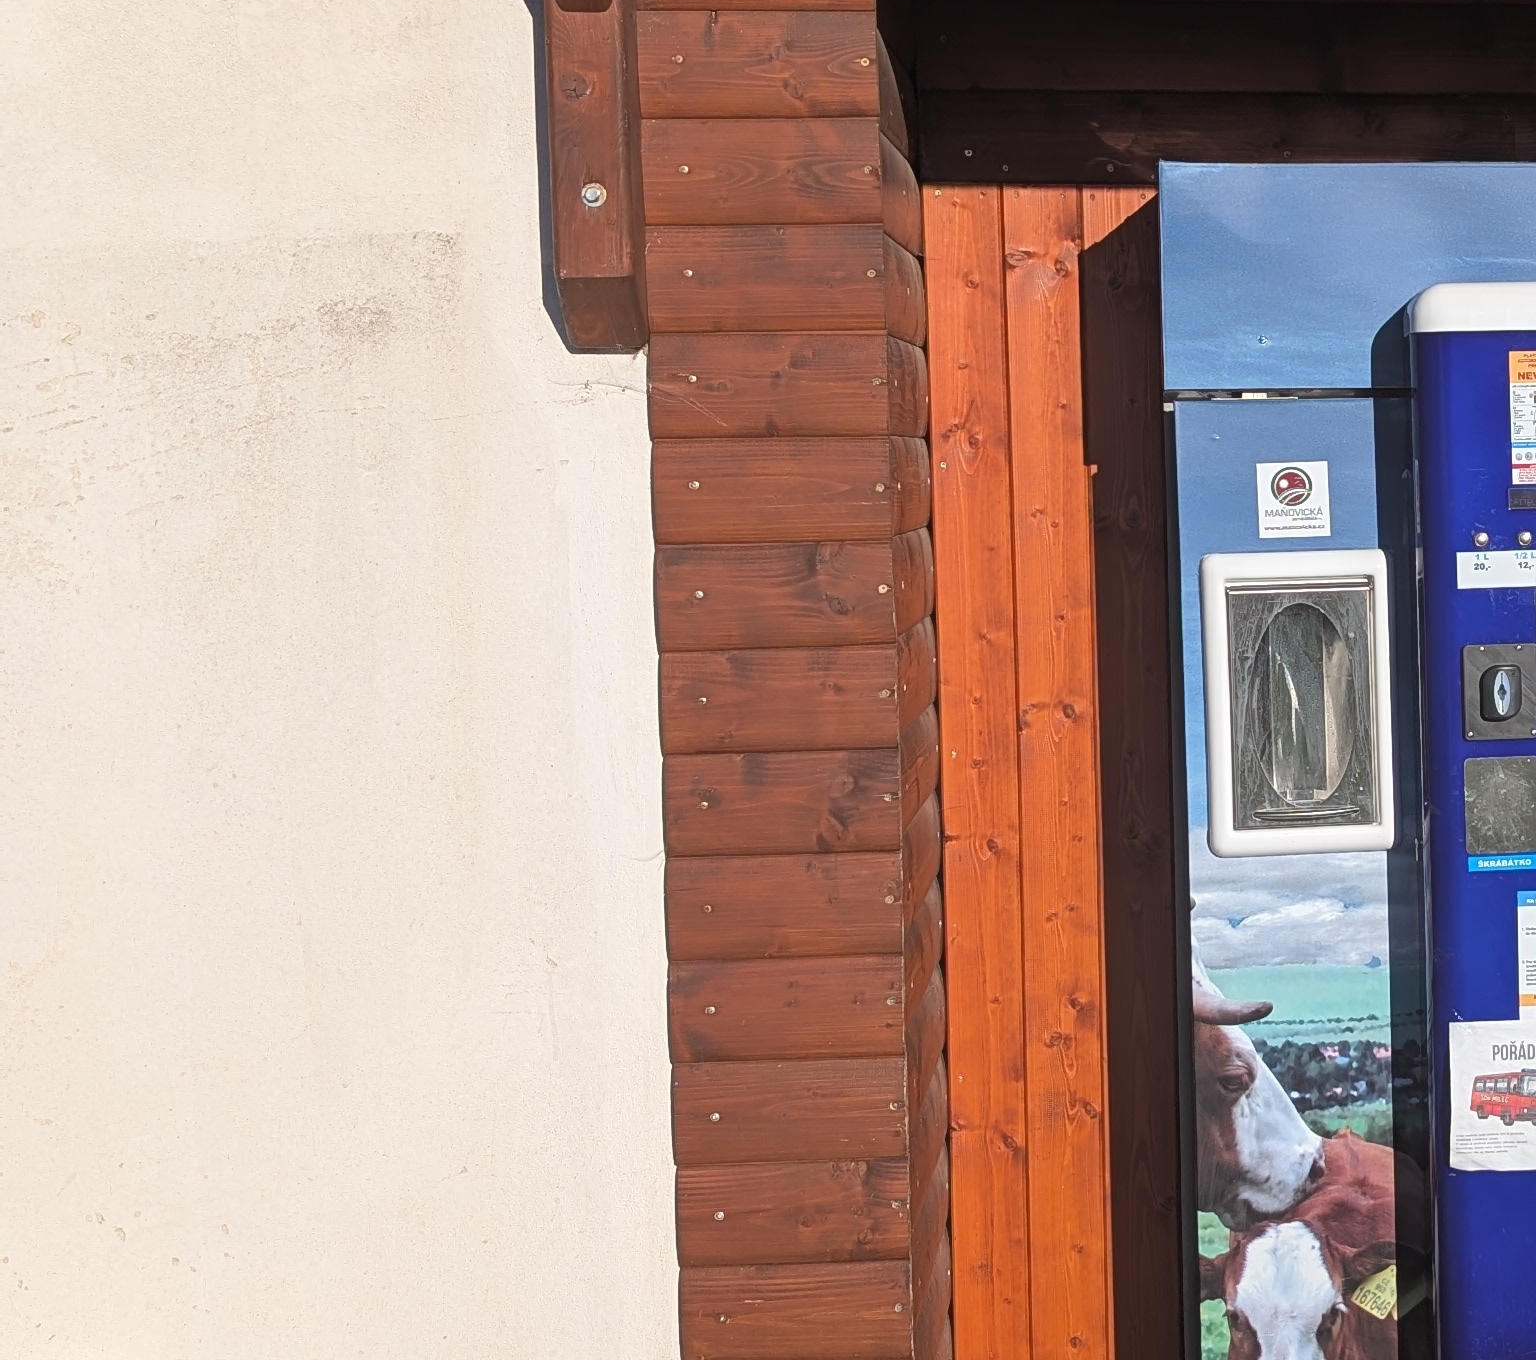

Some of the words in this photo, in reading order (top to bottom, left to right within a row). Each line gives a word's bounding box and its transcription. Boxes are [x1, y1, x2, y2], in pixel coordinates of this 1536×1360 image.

[1265, 506, 1323, 517] MAŇOVICKÁ
[1474, 563, 1491, 571] 20,-
[1518, 562, 1534, 570] 12,-
[1354, 1285, 1391, 1316] 167646
